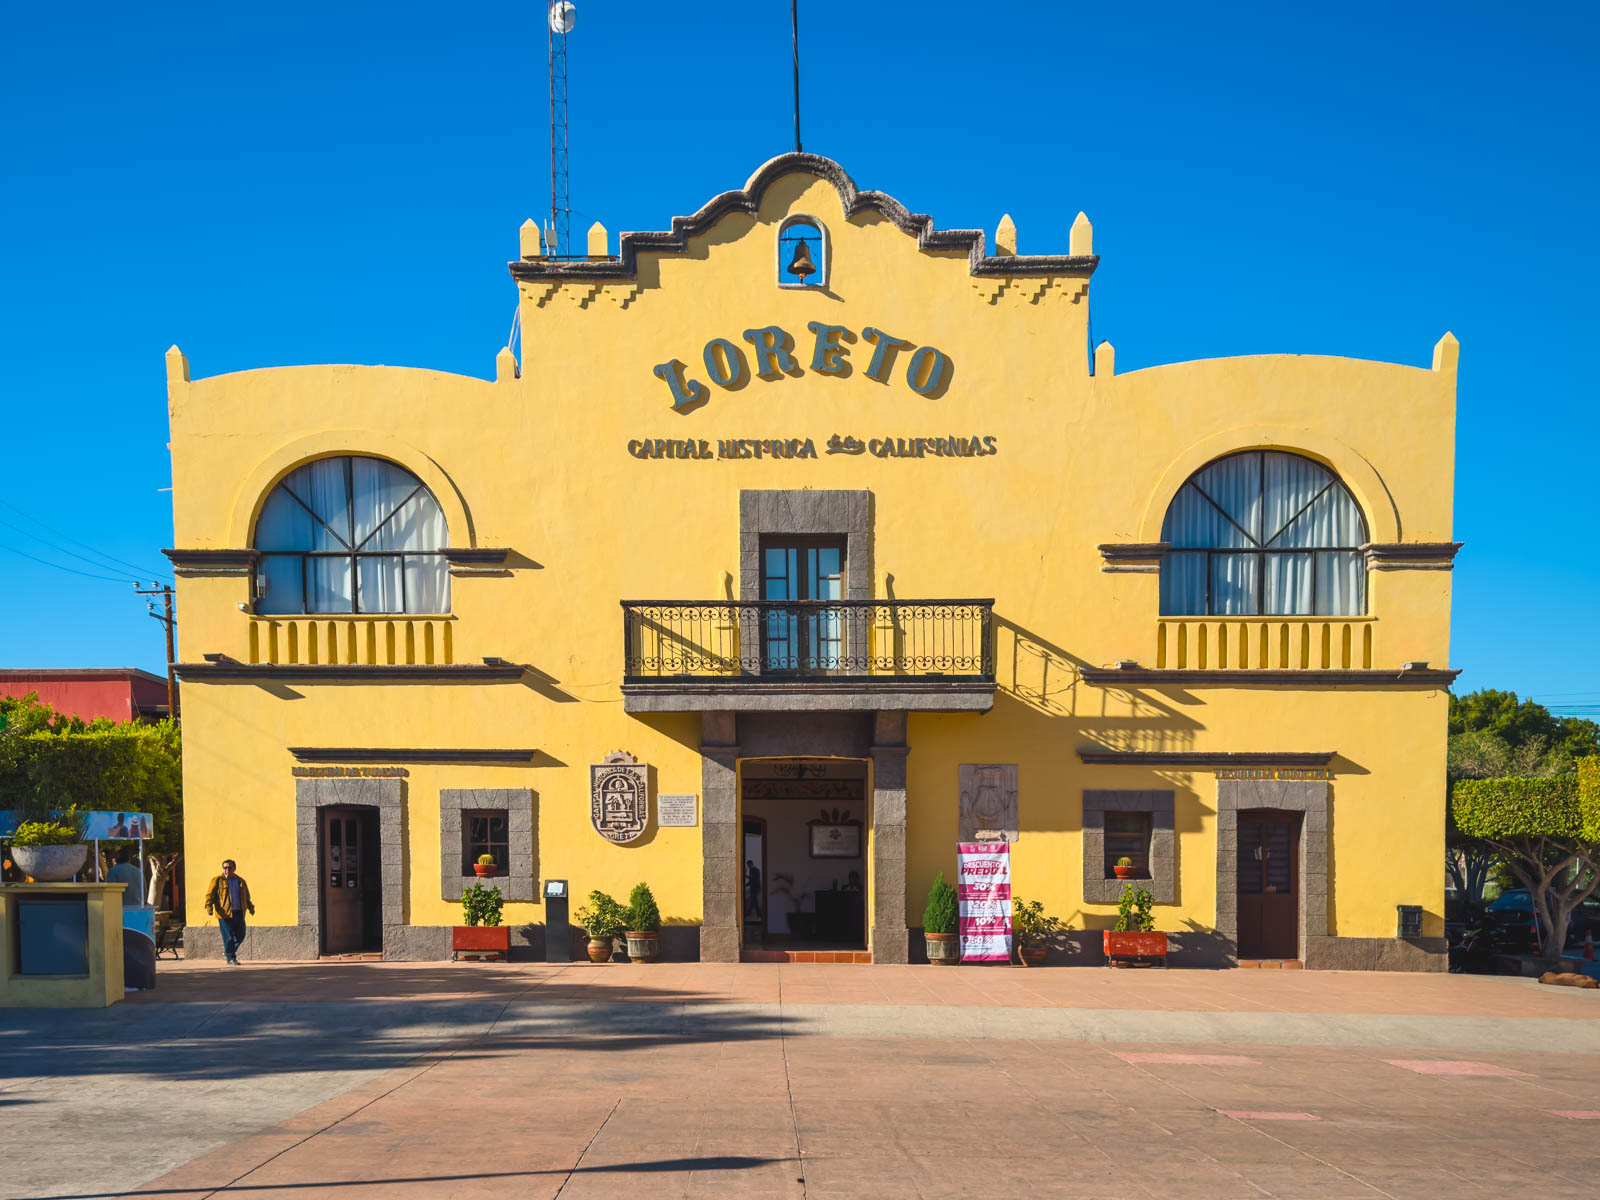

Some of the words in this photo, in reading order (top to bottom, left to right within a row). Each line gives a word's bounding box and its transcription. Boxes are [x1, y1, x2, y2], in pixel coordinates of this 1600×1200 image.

[653, 321, 950, 412] LORETO
[628, 438, 712, 459] CAPITAL
[868, 436, 997, 458] CALIFORNIAS
[963, 860, 1005, 869] DESCUENTO
